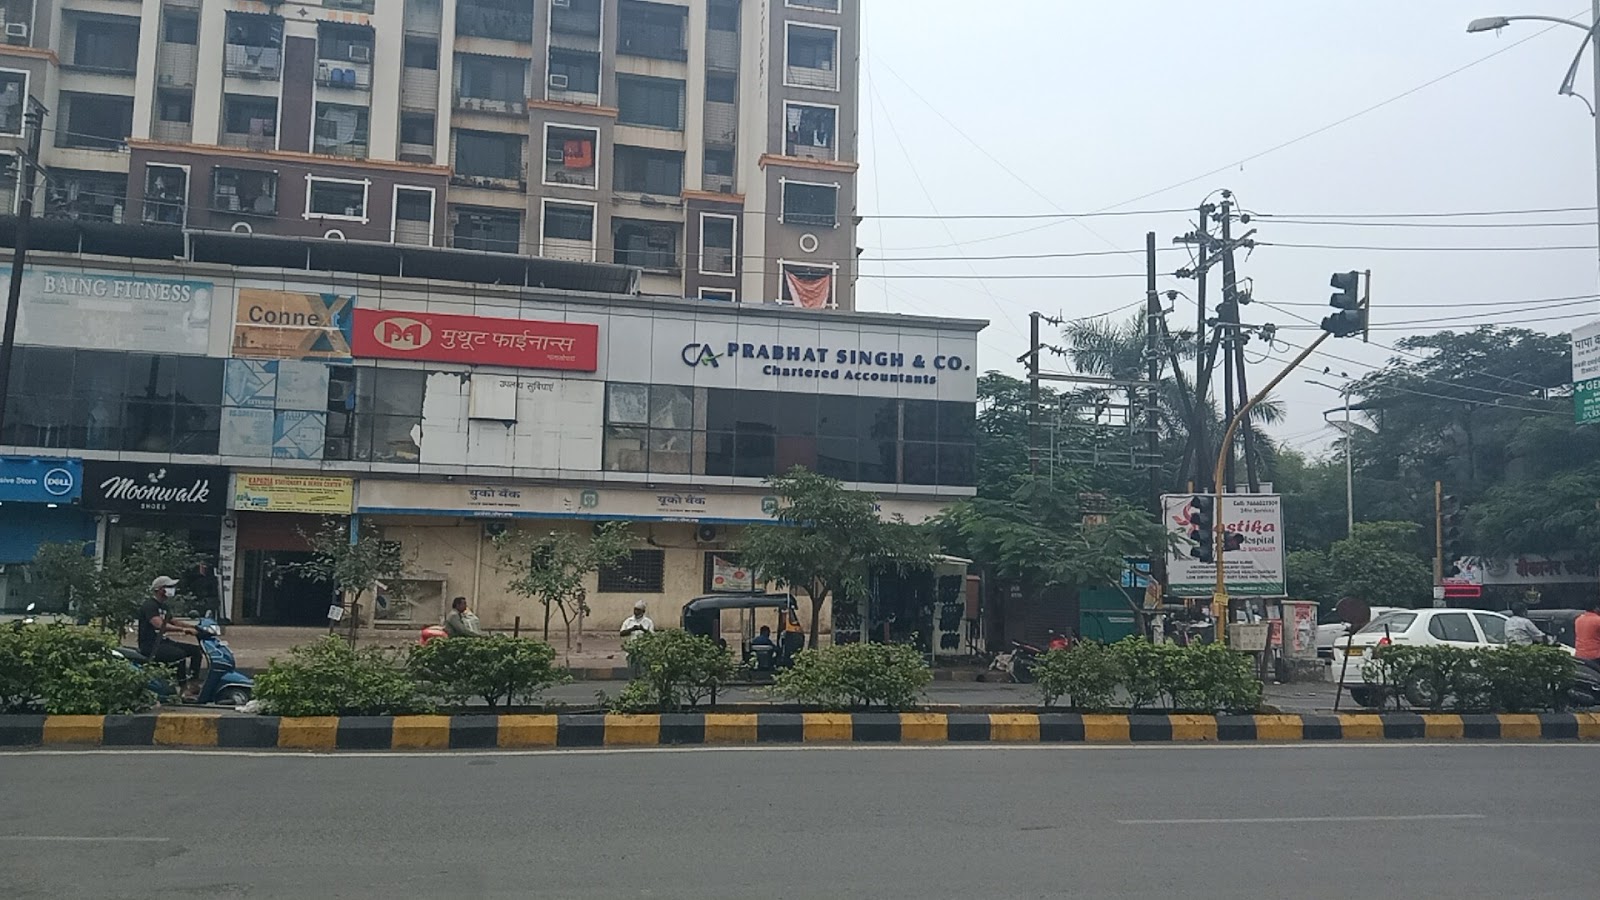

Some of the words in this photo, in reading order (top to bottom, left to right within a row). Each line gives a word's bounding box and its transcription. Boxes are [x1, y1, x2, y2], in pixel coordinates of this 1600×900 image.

[43, 275, 107, 297] BAING
[112, 280, 191, 302] FITNESS
[440, 328, 489, 350] मुथूट
[492, 329, 576, 352] फाईनान्स
[727, 342, 829, 363] PRABHAT
[836, 349, 904, 368] SINGH
[912, 354, 926, 369] &
[933, 355, 971, 371] CO.
[762, 365, 839, 380] Chartered
[844, 370, 936, 385] Accountants
[16, 477, 37, 485] Store
[47, 478, 70, 486] DELL
[100, 475, 210, 503] Moonwalk
